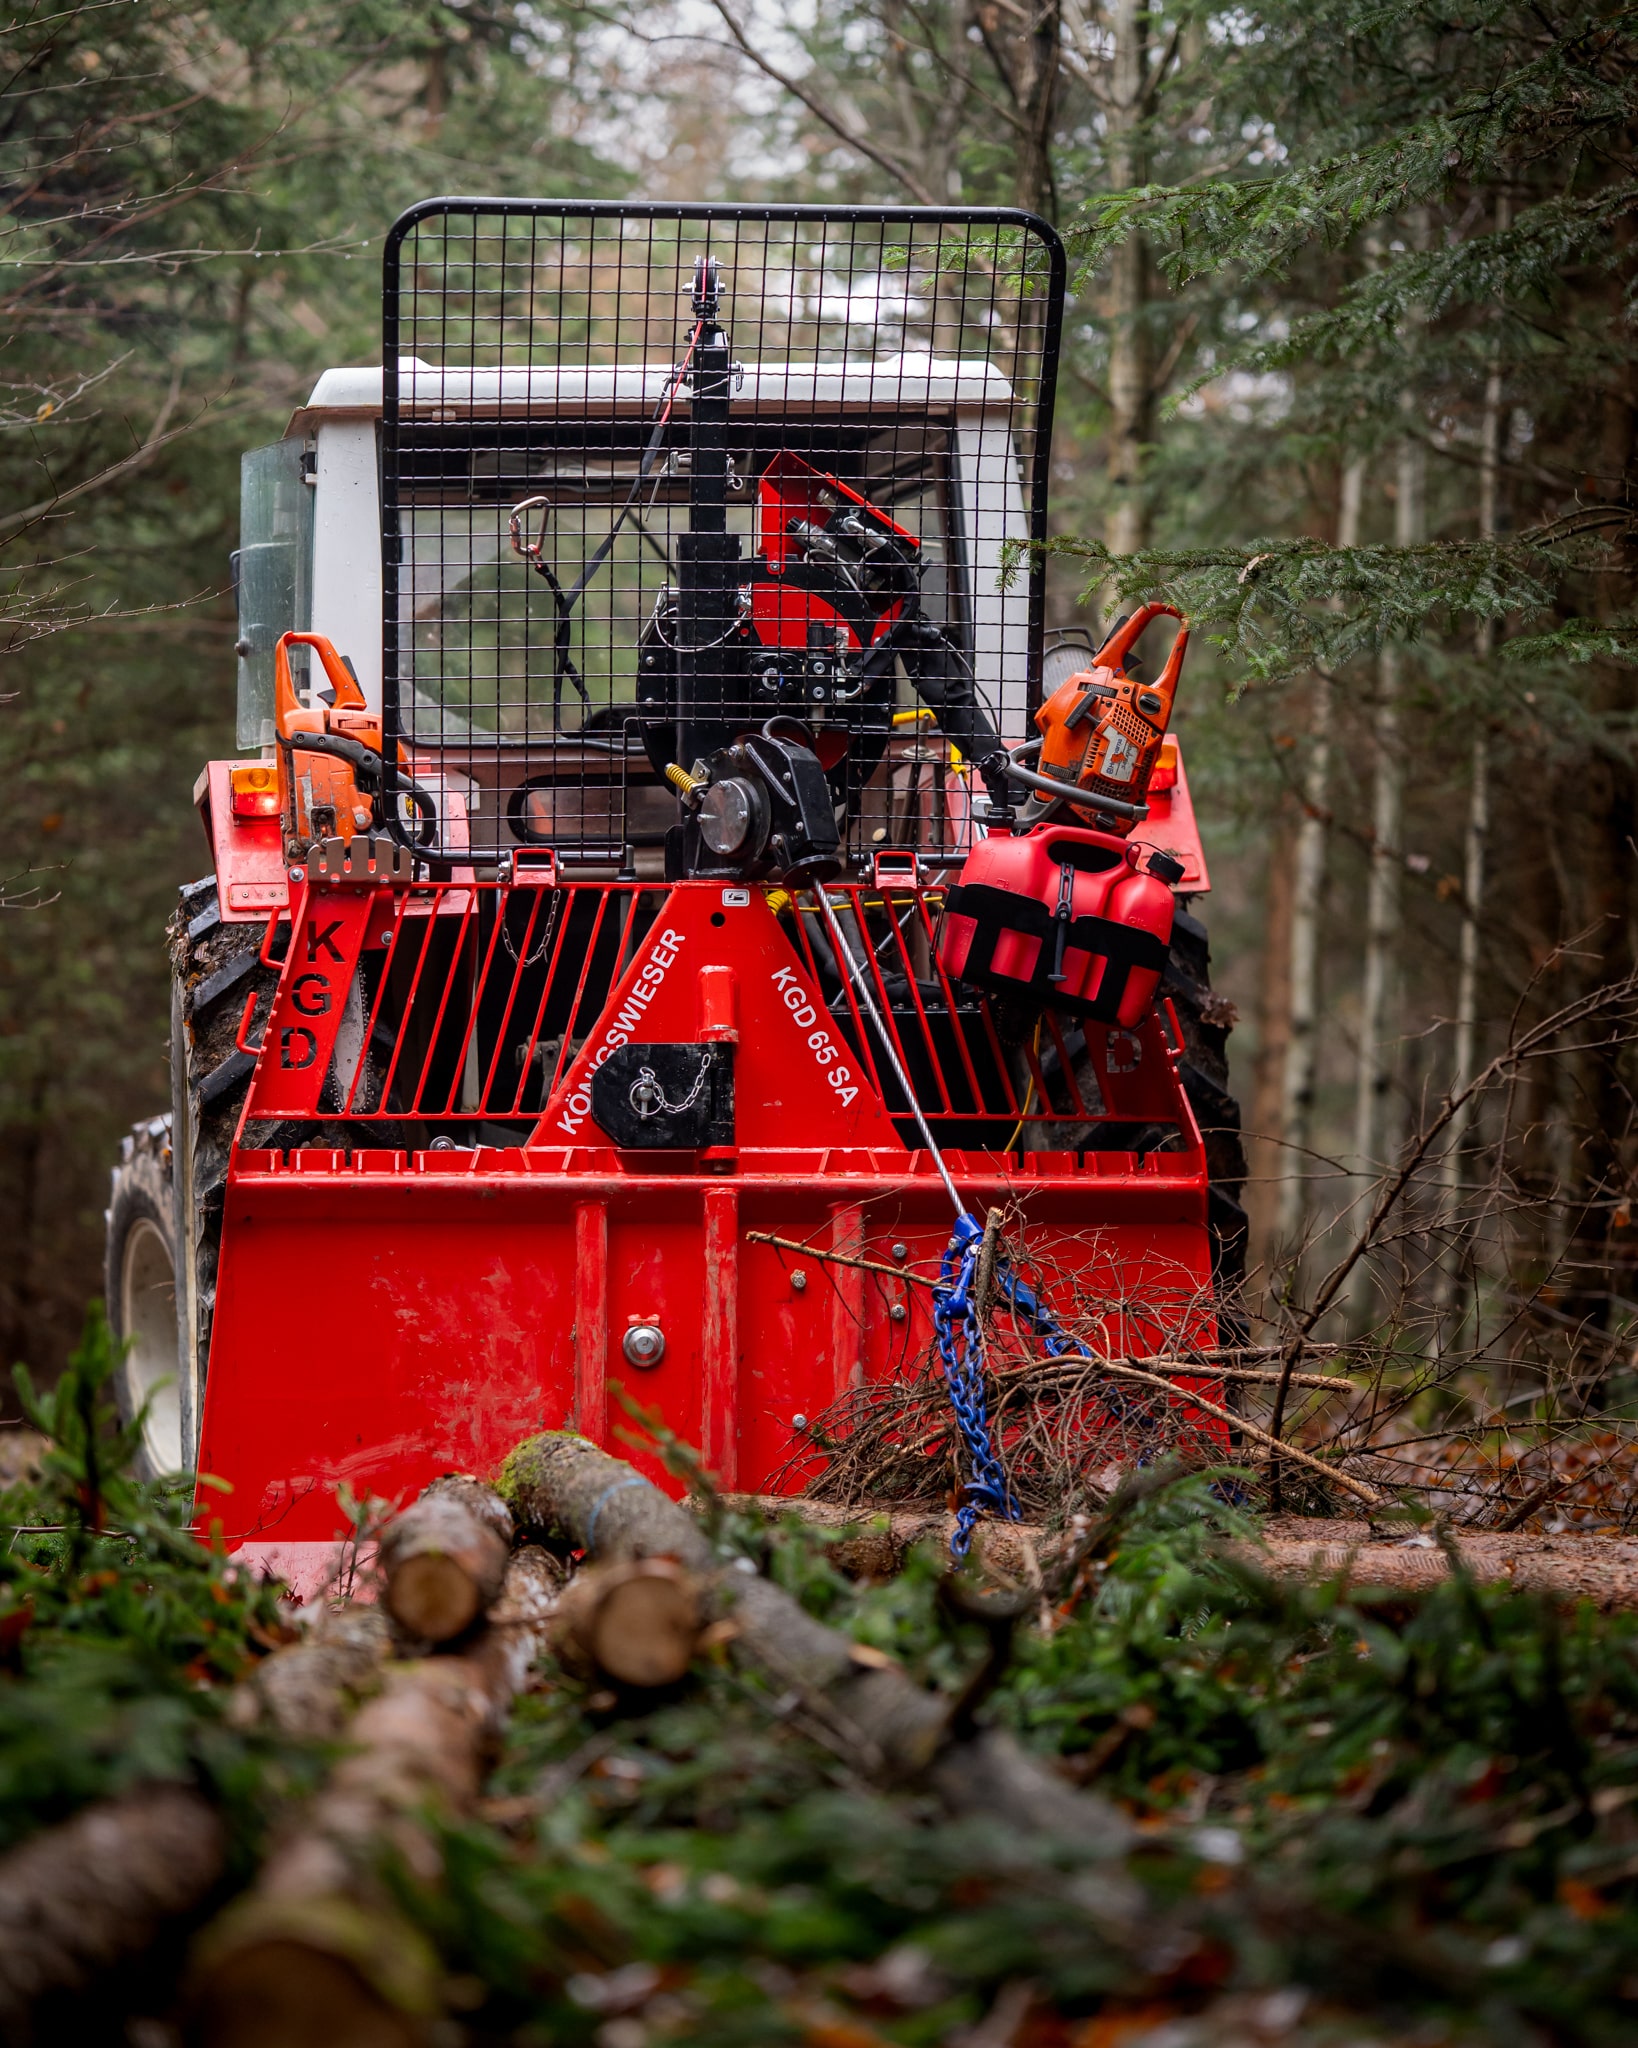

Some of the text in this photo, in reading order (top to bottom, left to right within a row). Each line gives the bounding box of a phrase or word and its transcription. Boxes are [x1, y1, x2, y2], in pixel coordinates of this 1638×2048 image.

[771, 966, 859, 1108] KGD 65 SA
